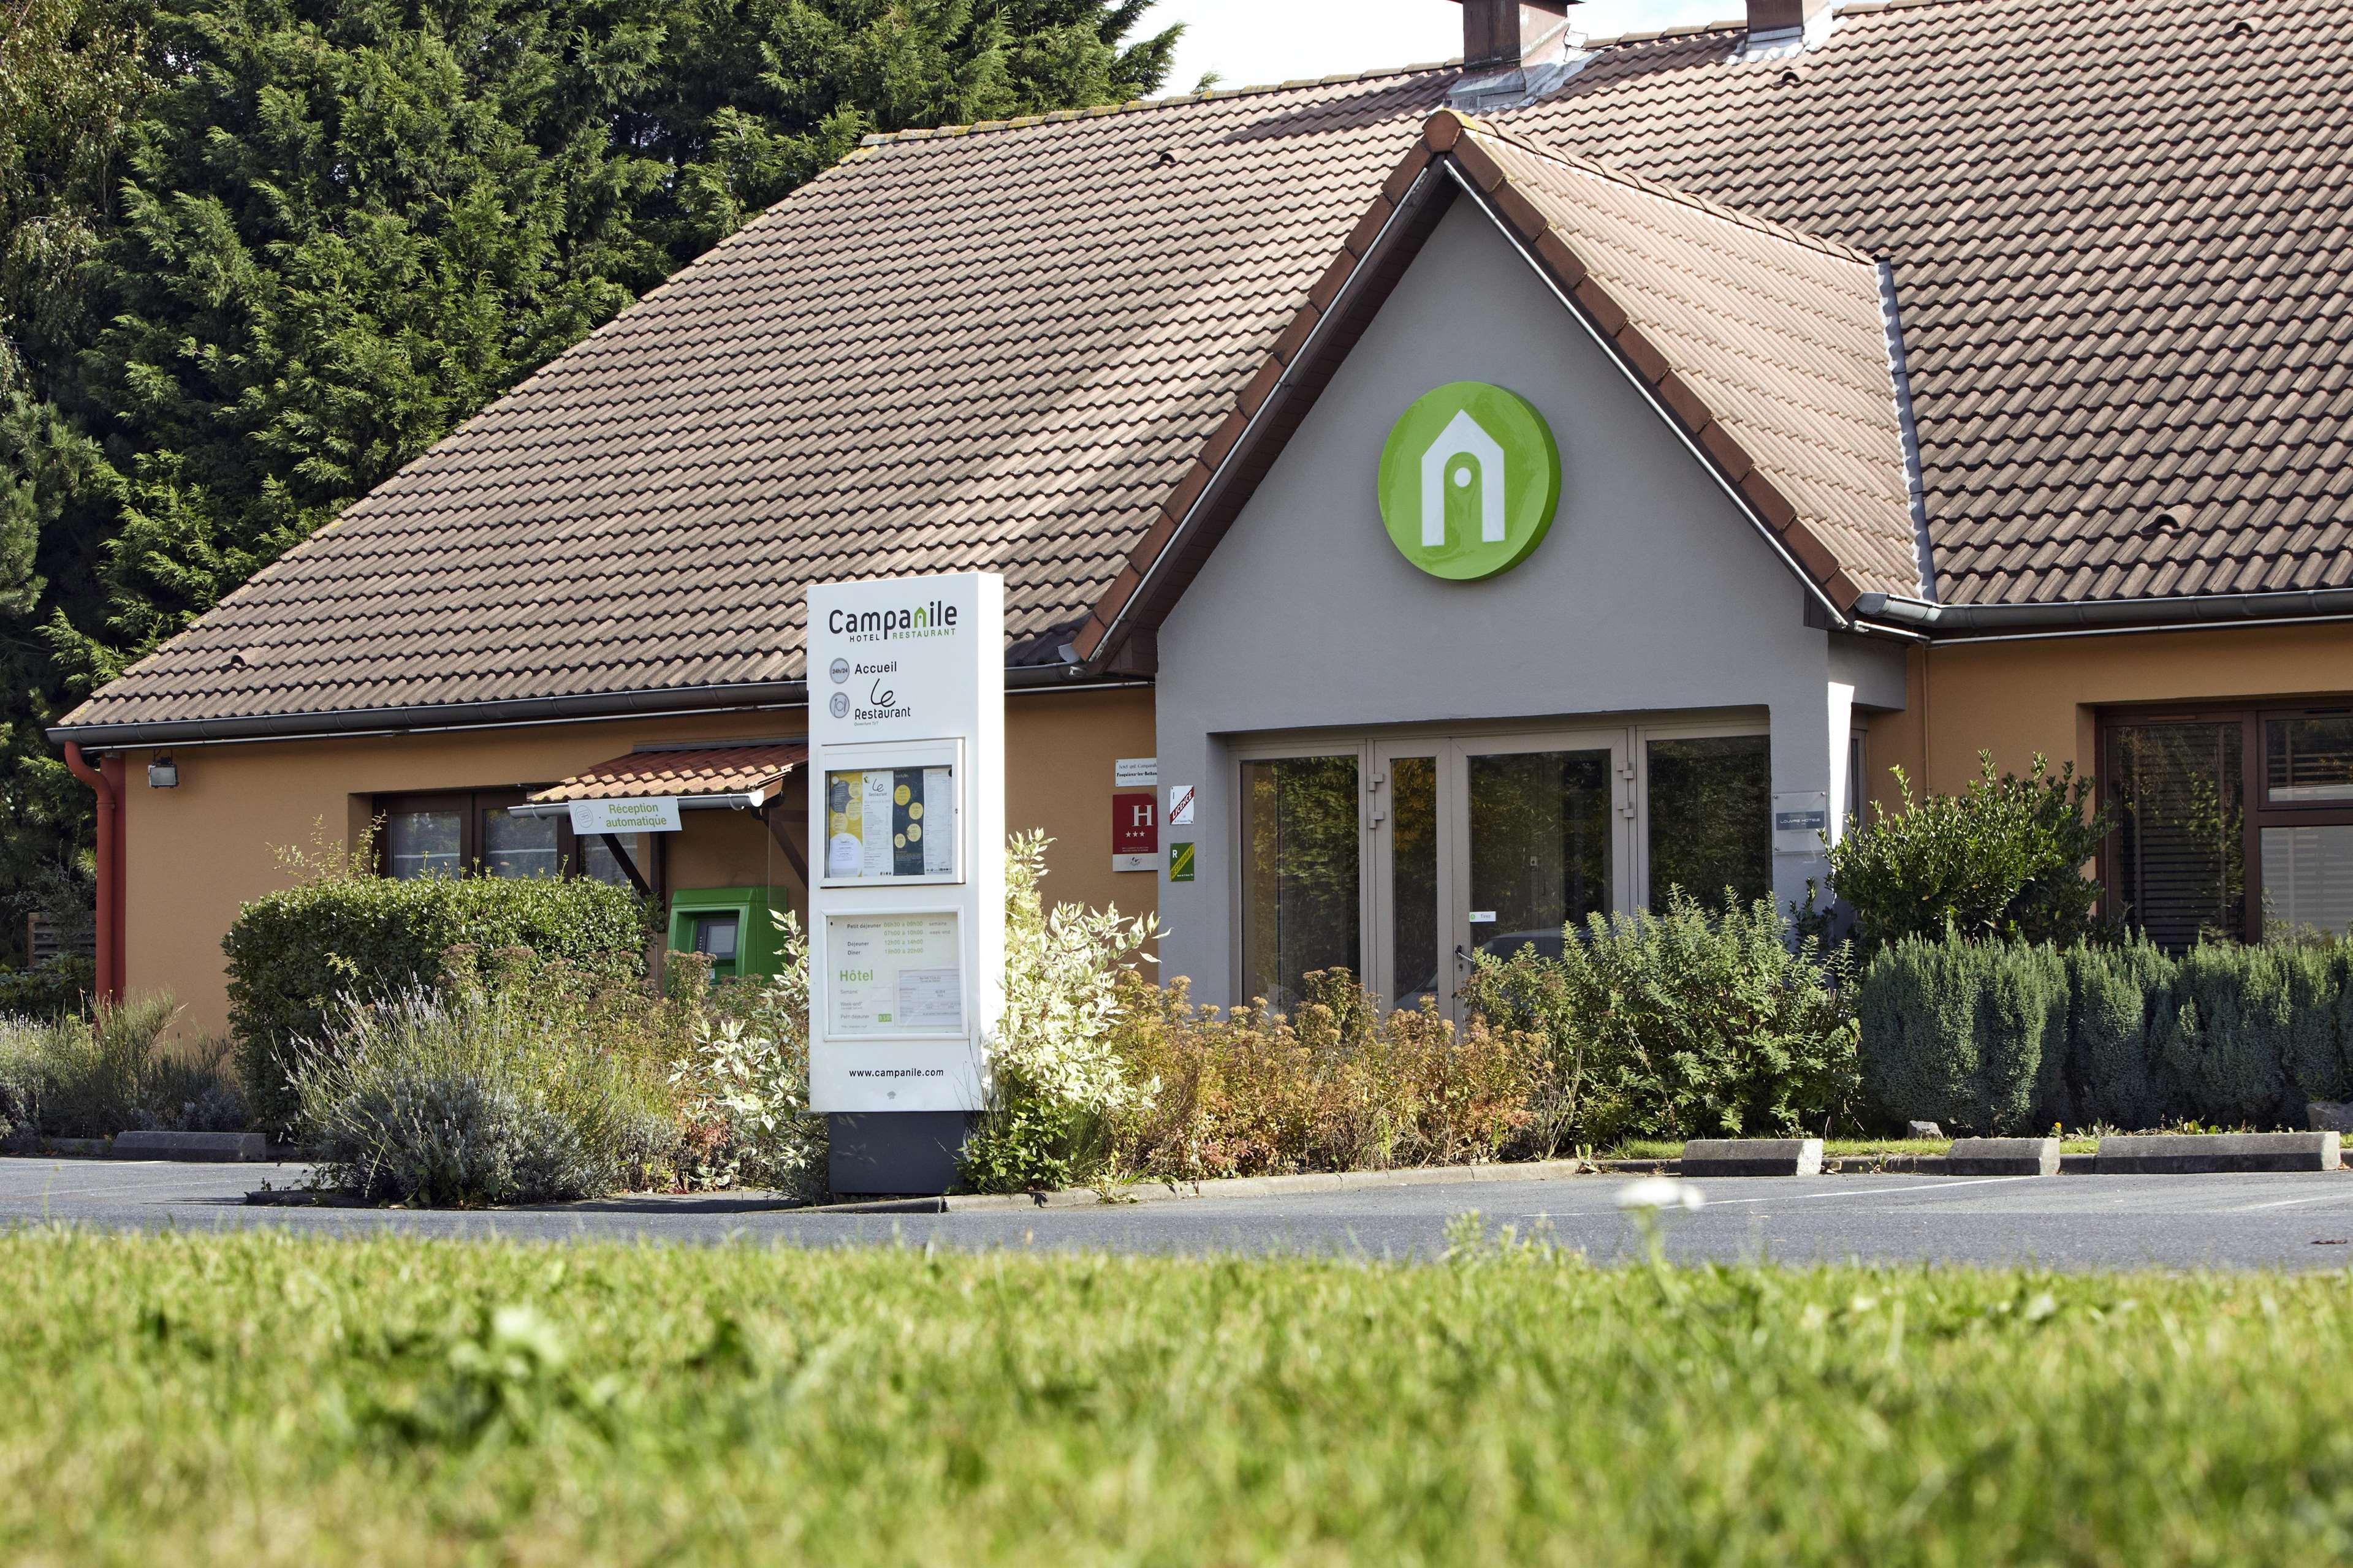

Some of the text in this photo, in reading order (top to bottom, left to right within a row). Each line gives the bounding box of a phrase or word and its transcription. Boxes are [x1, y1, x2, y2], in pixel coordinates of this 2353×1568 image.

[829, 600, 957, 640] Campanile
[850, 628, 956, 642] HOTEL RESTAURANT
[854, 661, 897, 675] Accueil
[854, 706, 911, 720] Restaurant
[609, 803, 659, 815] Réception
[1173, 790, 1192, 819] LICENCE
[606, 816, 667, 828] automatique
[1132, 805, 1154, 827] H
[1172, 849, 1177, 858] R
[840, 969, 873, 981] Hôtel
[849, 1068, 944, 1078] www.campanile.com
